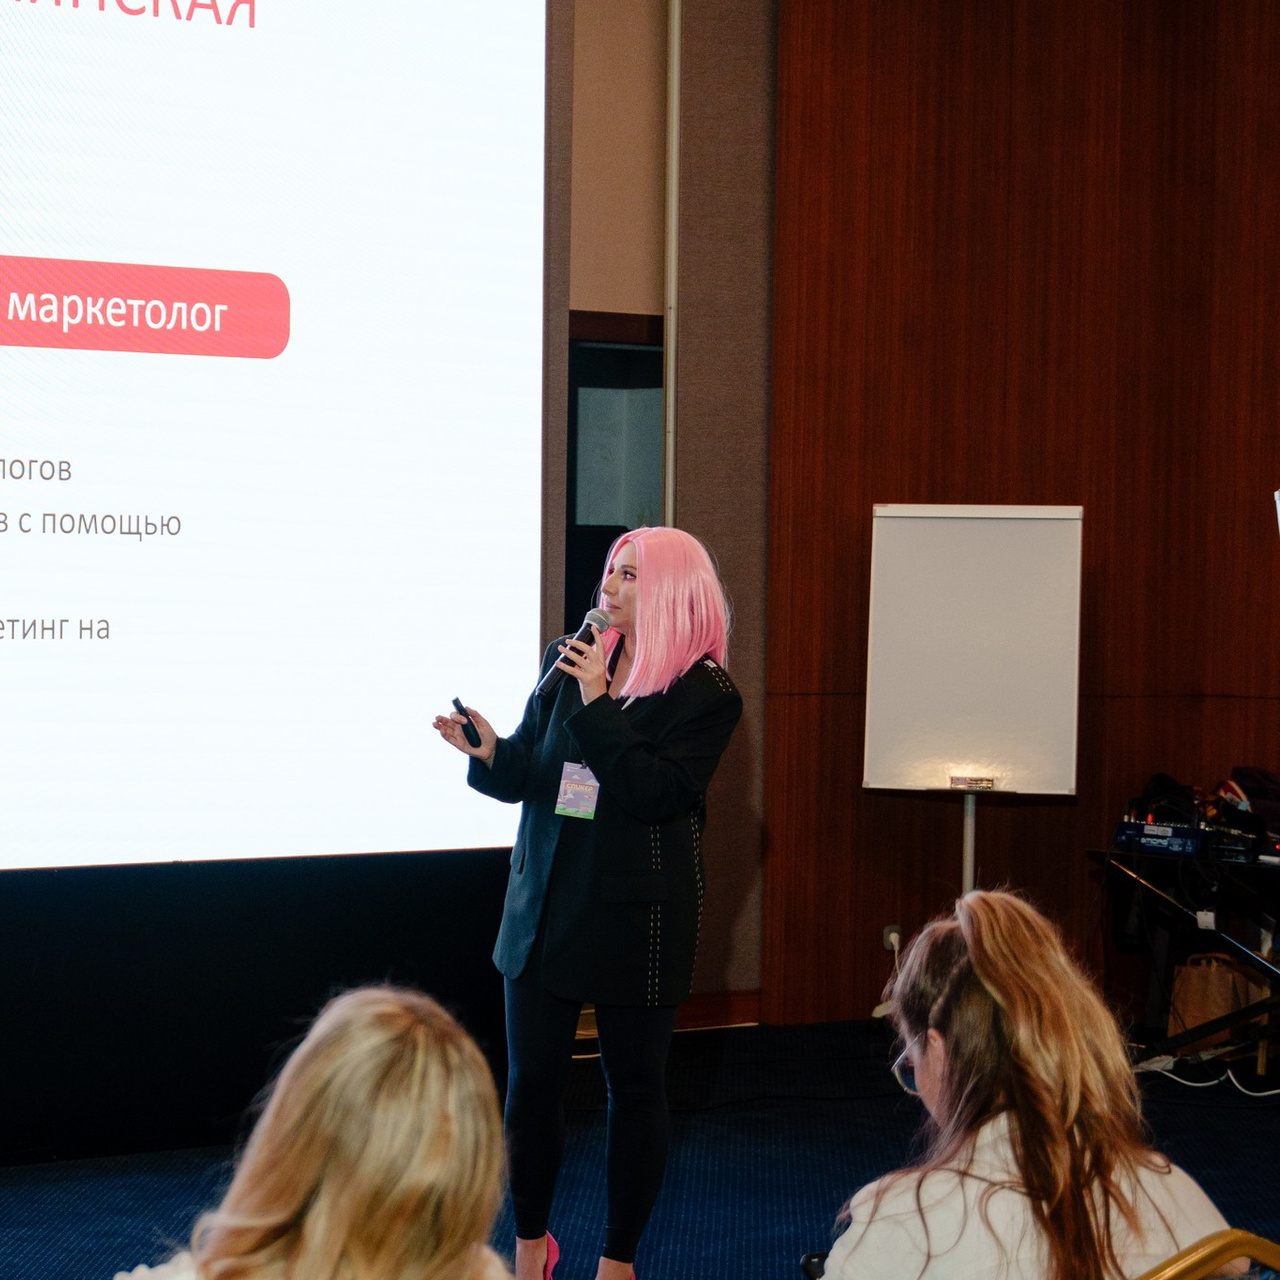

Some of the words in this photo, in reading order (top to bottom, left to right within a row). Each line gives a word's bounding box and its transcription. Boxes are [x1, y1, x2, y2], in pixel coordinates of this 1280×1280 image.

[19, 513, 31, 533] с
[43, 514, 180, 541] помощью
[80, 620, 109, 639] на
